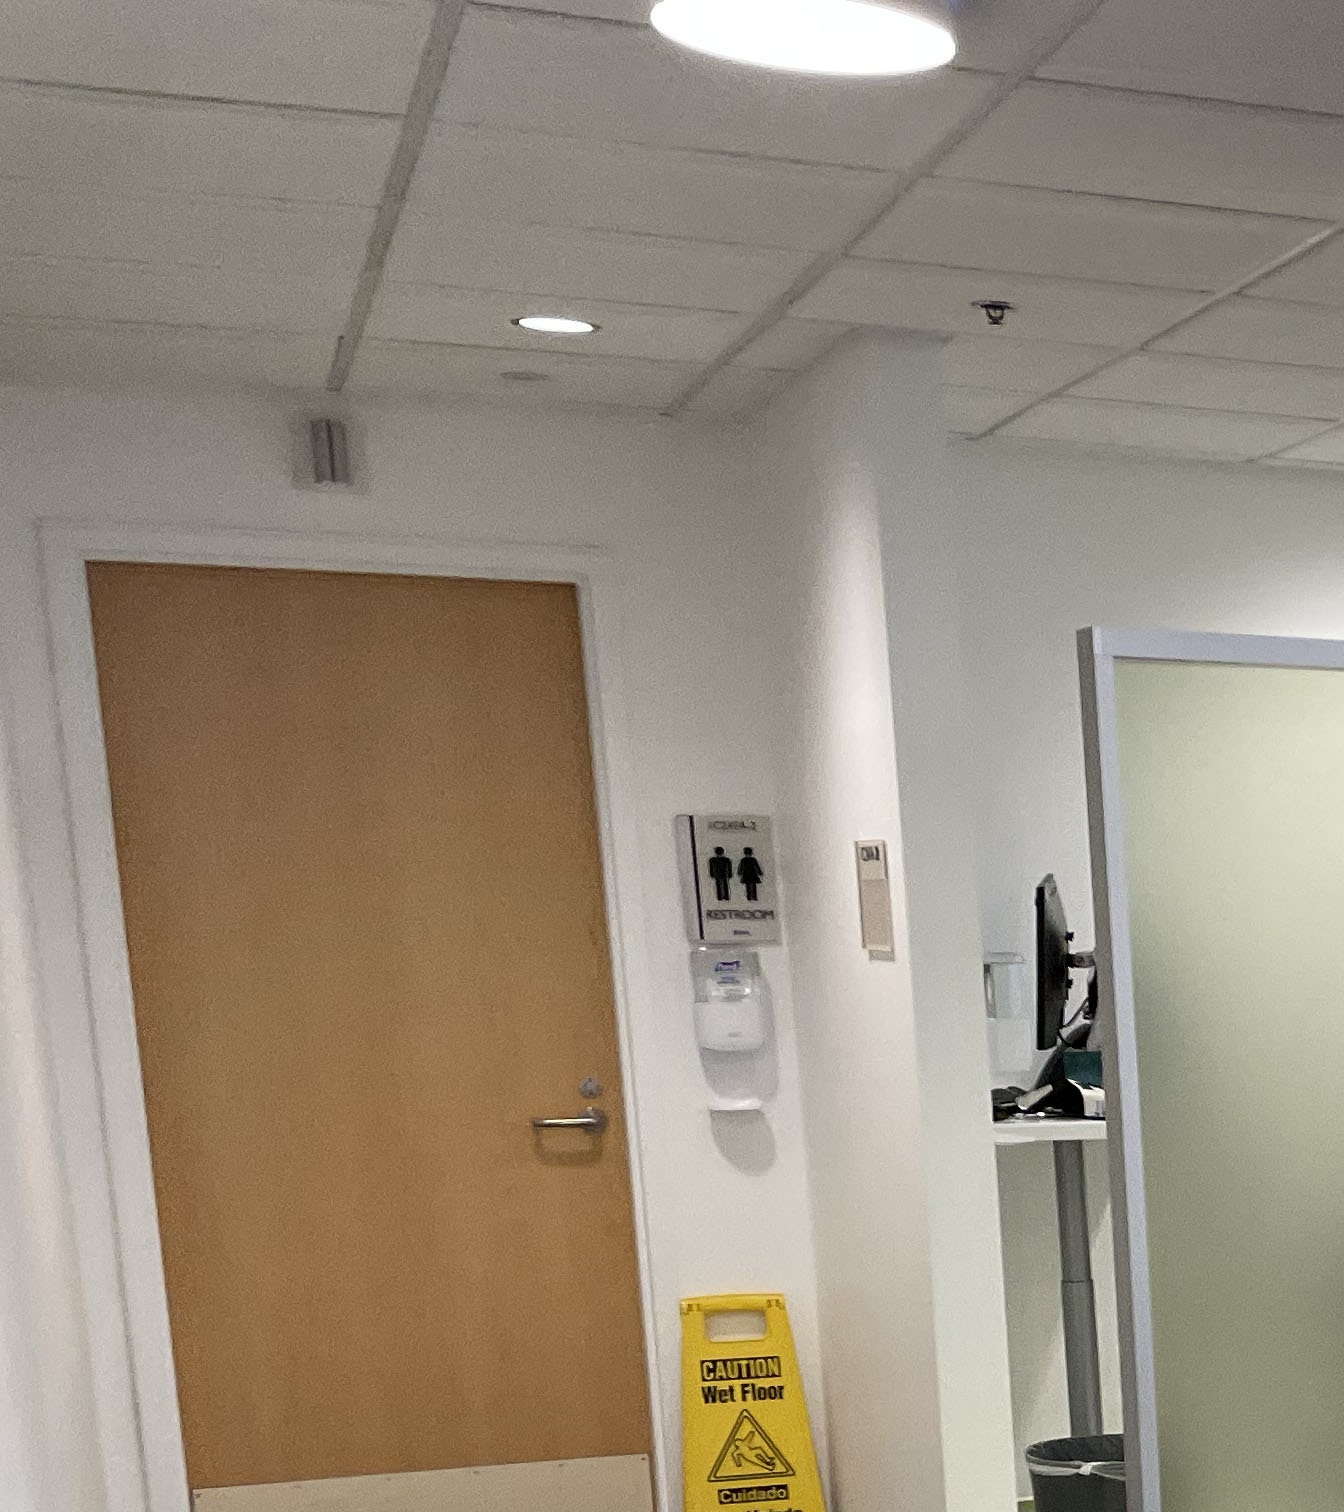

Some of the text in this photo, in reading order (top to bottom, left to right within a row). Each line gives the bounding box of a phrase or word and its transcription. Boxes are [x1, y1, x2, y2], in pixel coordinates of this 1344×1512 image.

[706, 909, 774, 920] RESTROOM
[702, 1358, 780, 1381] CAUTION
[702, 1382, 785, 1404] Wet Floor
[719, 1486, 788, 1503] Cuidado
